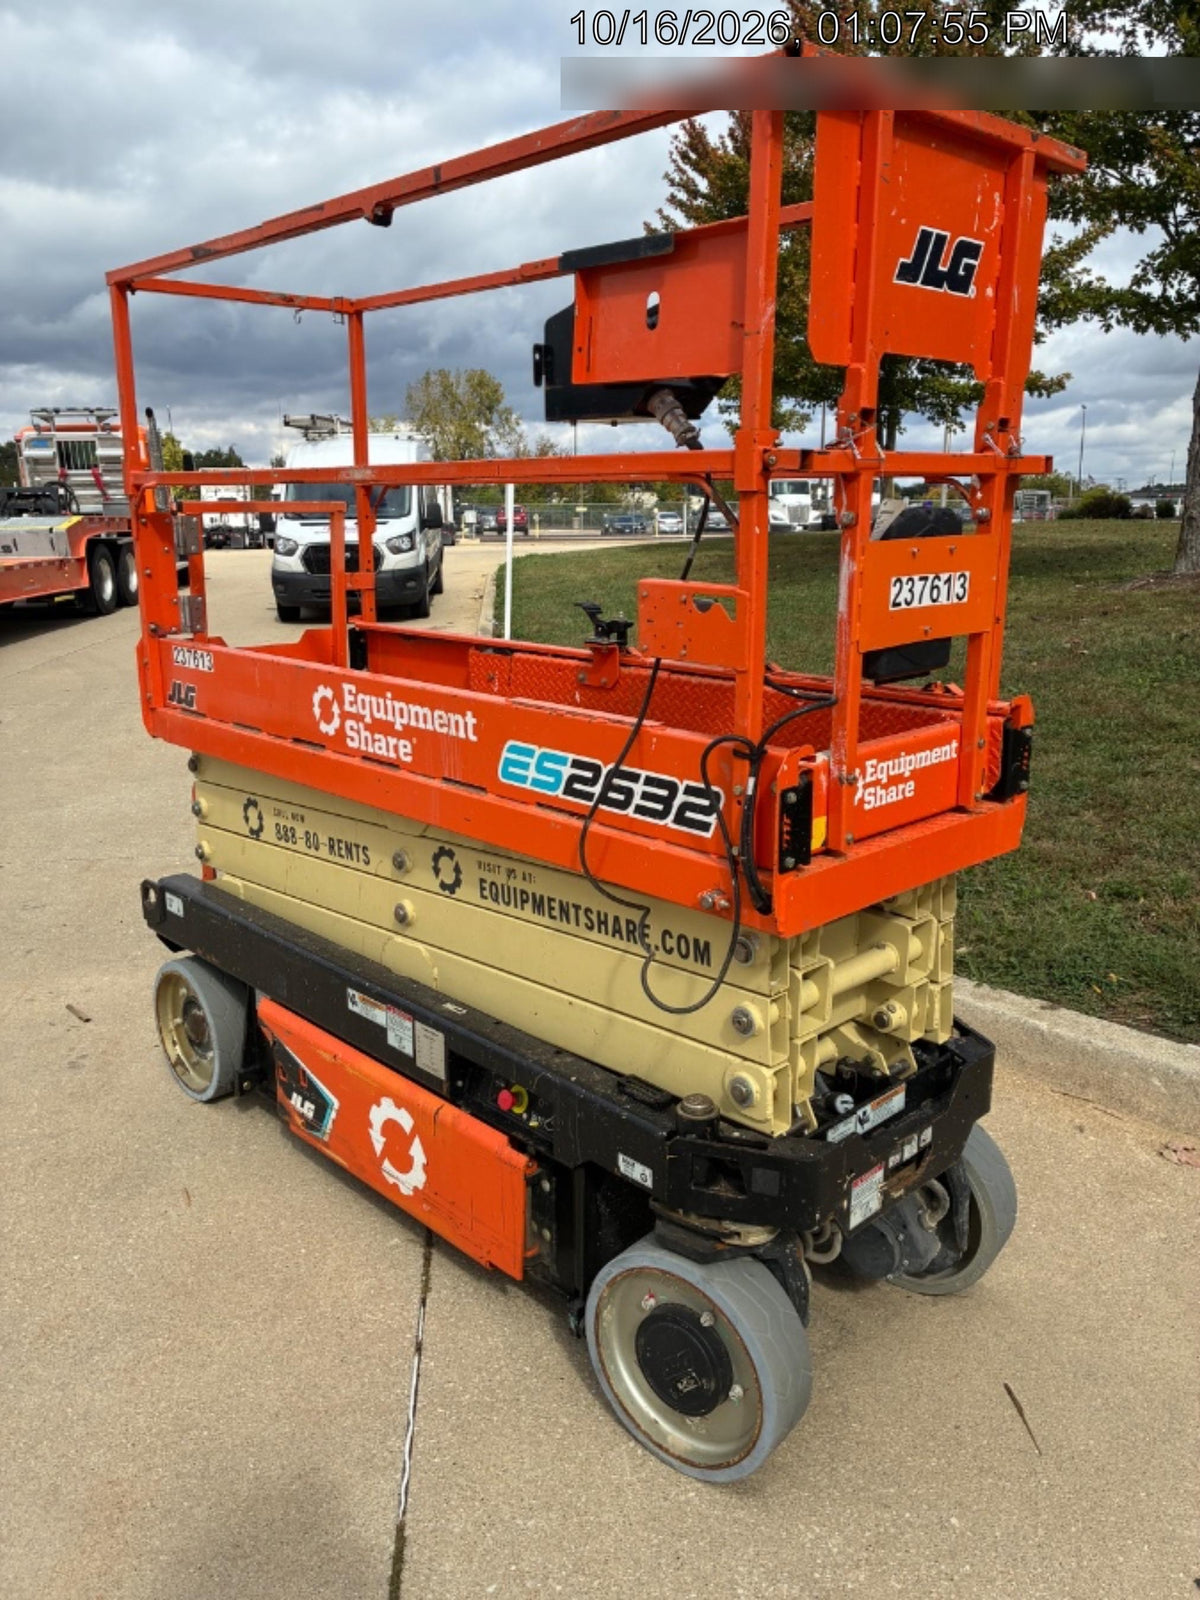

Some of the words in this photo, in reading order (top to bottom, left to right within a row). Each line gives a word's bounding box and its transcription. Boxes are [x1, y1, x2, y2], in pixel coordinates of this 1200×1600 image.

[893, 226, 985, 297] JLG
[891, 572, 968, 608] 237613
[173, 646, 213, 671] 237613
[167, 681, 196, 709] JLG
[342, 683, 478, 742] Equipment
[345, 719, 413, 763] Share
[864, 739, 958, 784] Equipment
[499, 740, 724, 838] ES2632
[863, 780, 915, 811] Share
[274, 822, 371, 866] 888-80-RENTS
[477, 859, 501, 876] VISIT
[479, 877, 711, 968] EQUIPMENTSHARE.COM
[290, 1091, 316, 1120] JLG
